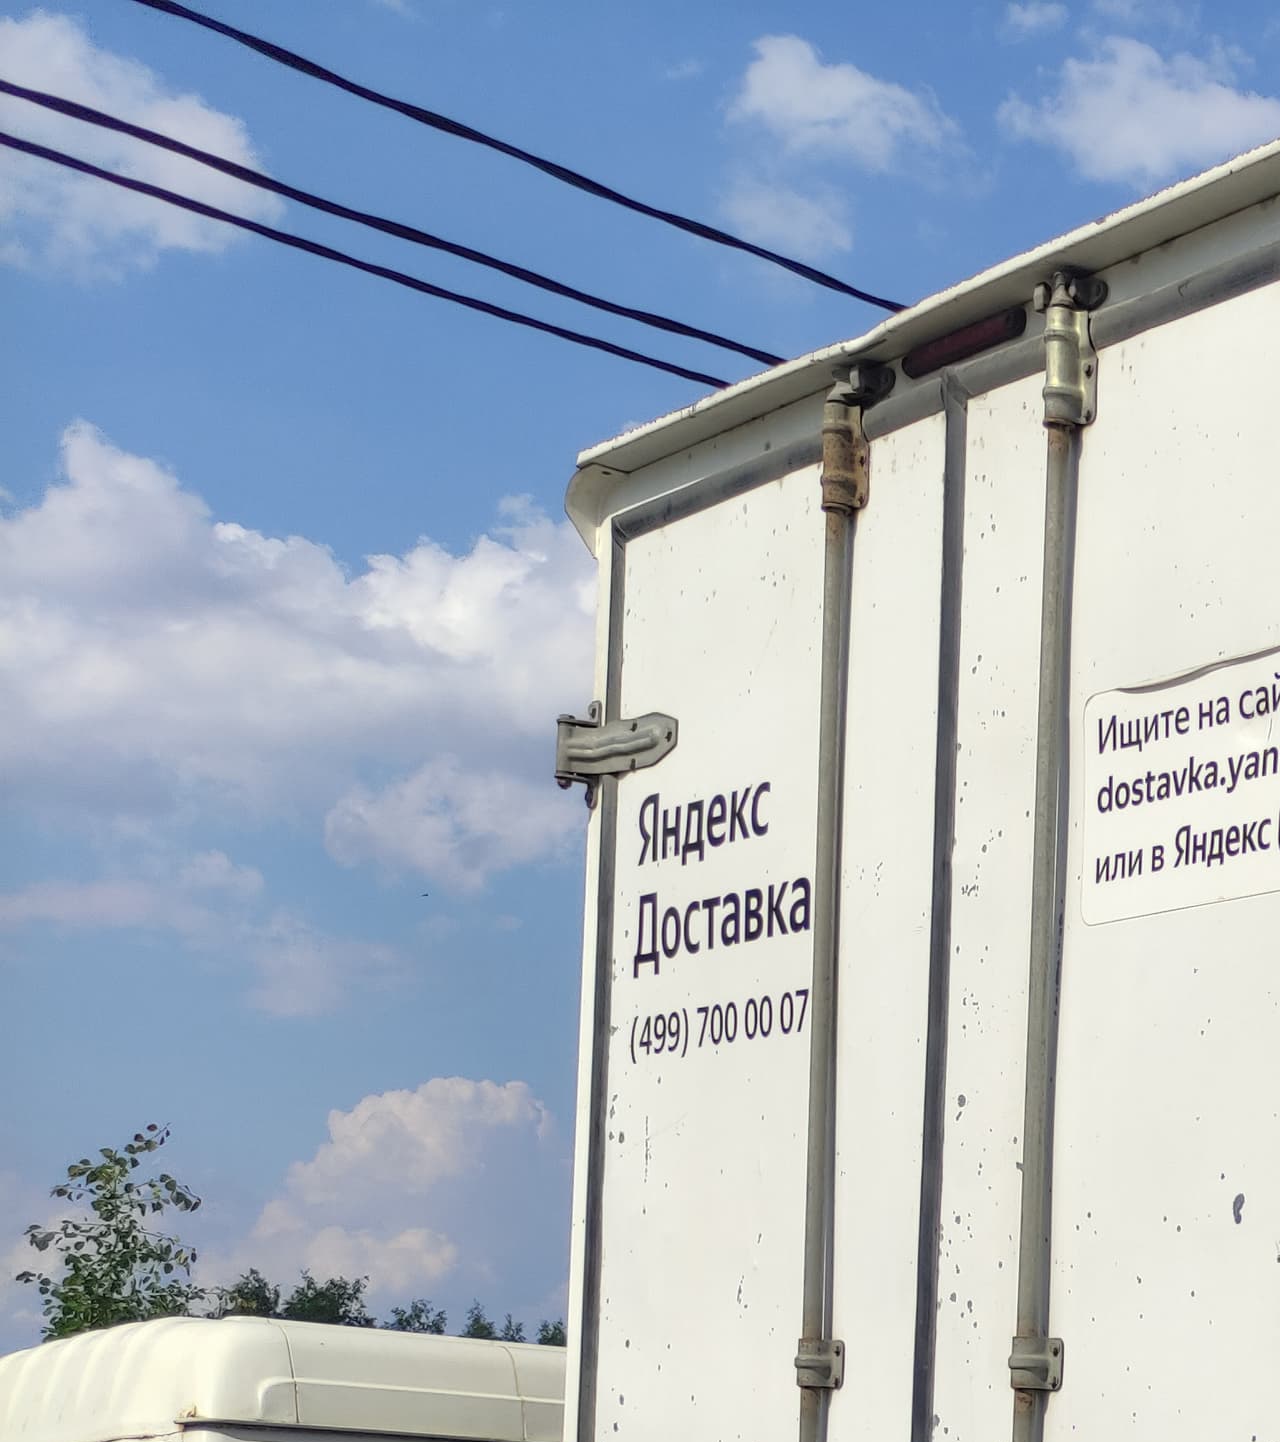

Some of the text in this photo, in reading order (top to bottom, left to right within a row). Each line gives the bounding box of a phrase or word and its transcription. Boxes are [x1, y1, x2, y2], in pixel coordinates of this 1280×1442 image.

[1098, 705, 1190, 754] Ищите
[1198, 696, 1230, 730] на
[638, 781, 771, 866] Яндекс
[1095, 848, 1143, 884] или
[1151, 845, 1165, 872] в
[1173, 818, 1271, 868] Яндекс
[633, 876, 811, 979] Доставка
[630, 988, 809, 1064] (499) 700 00 07
